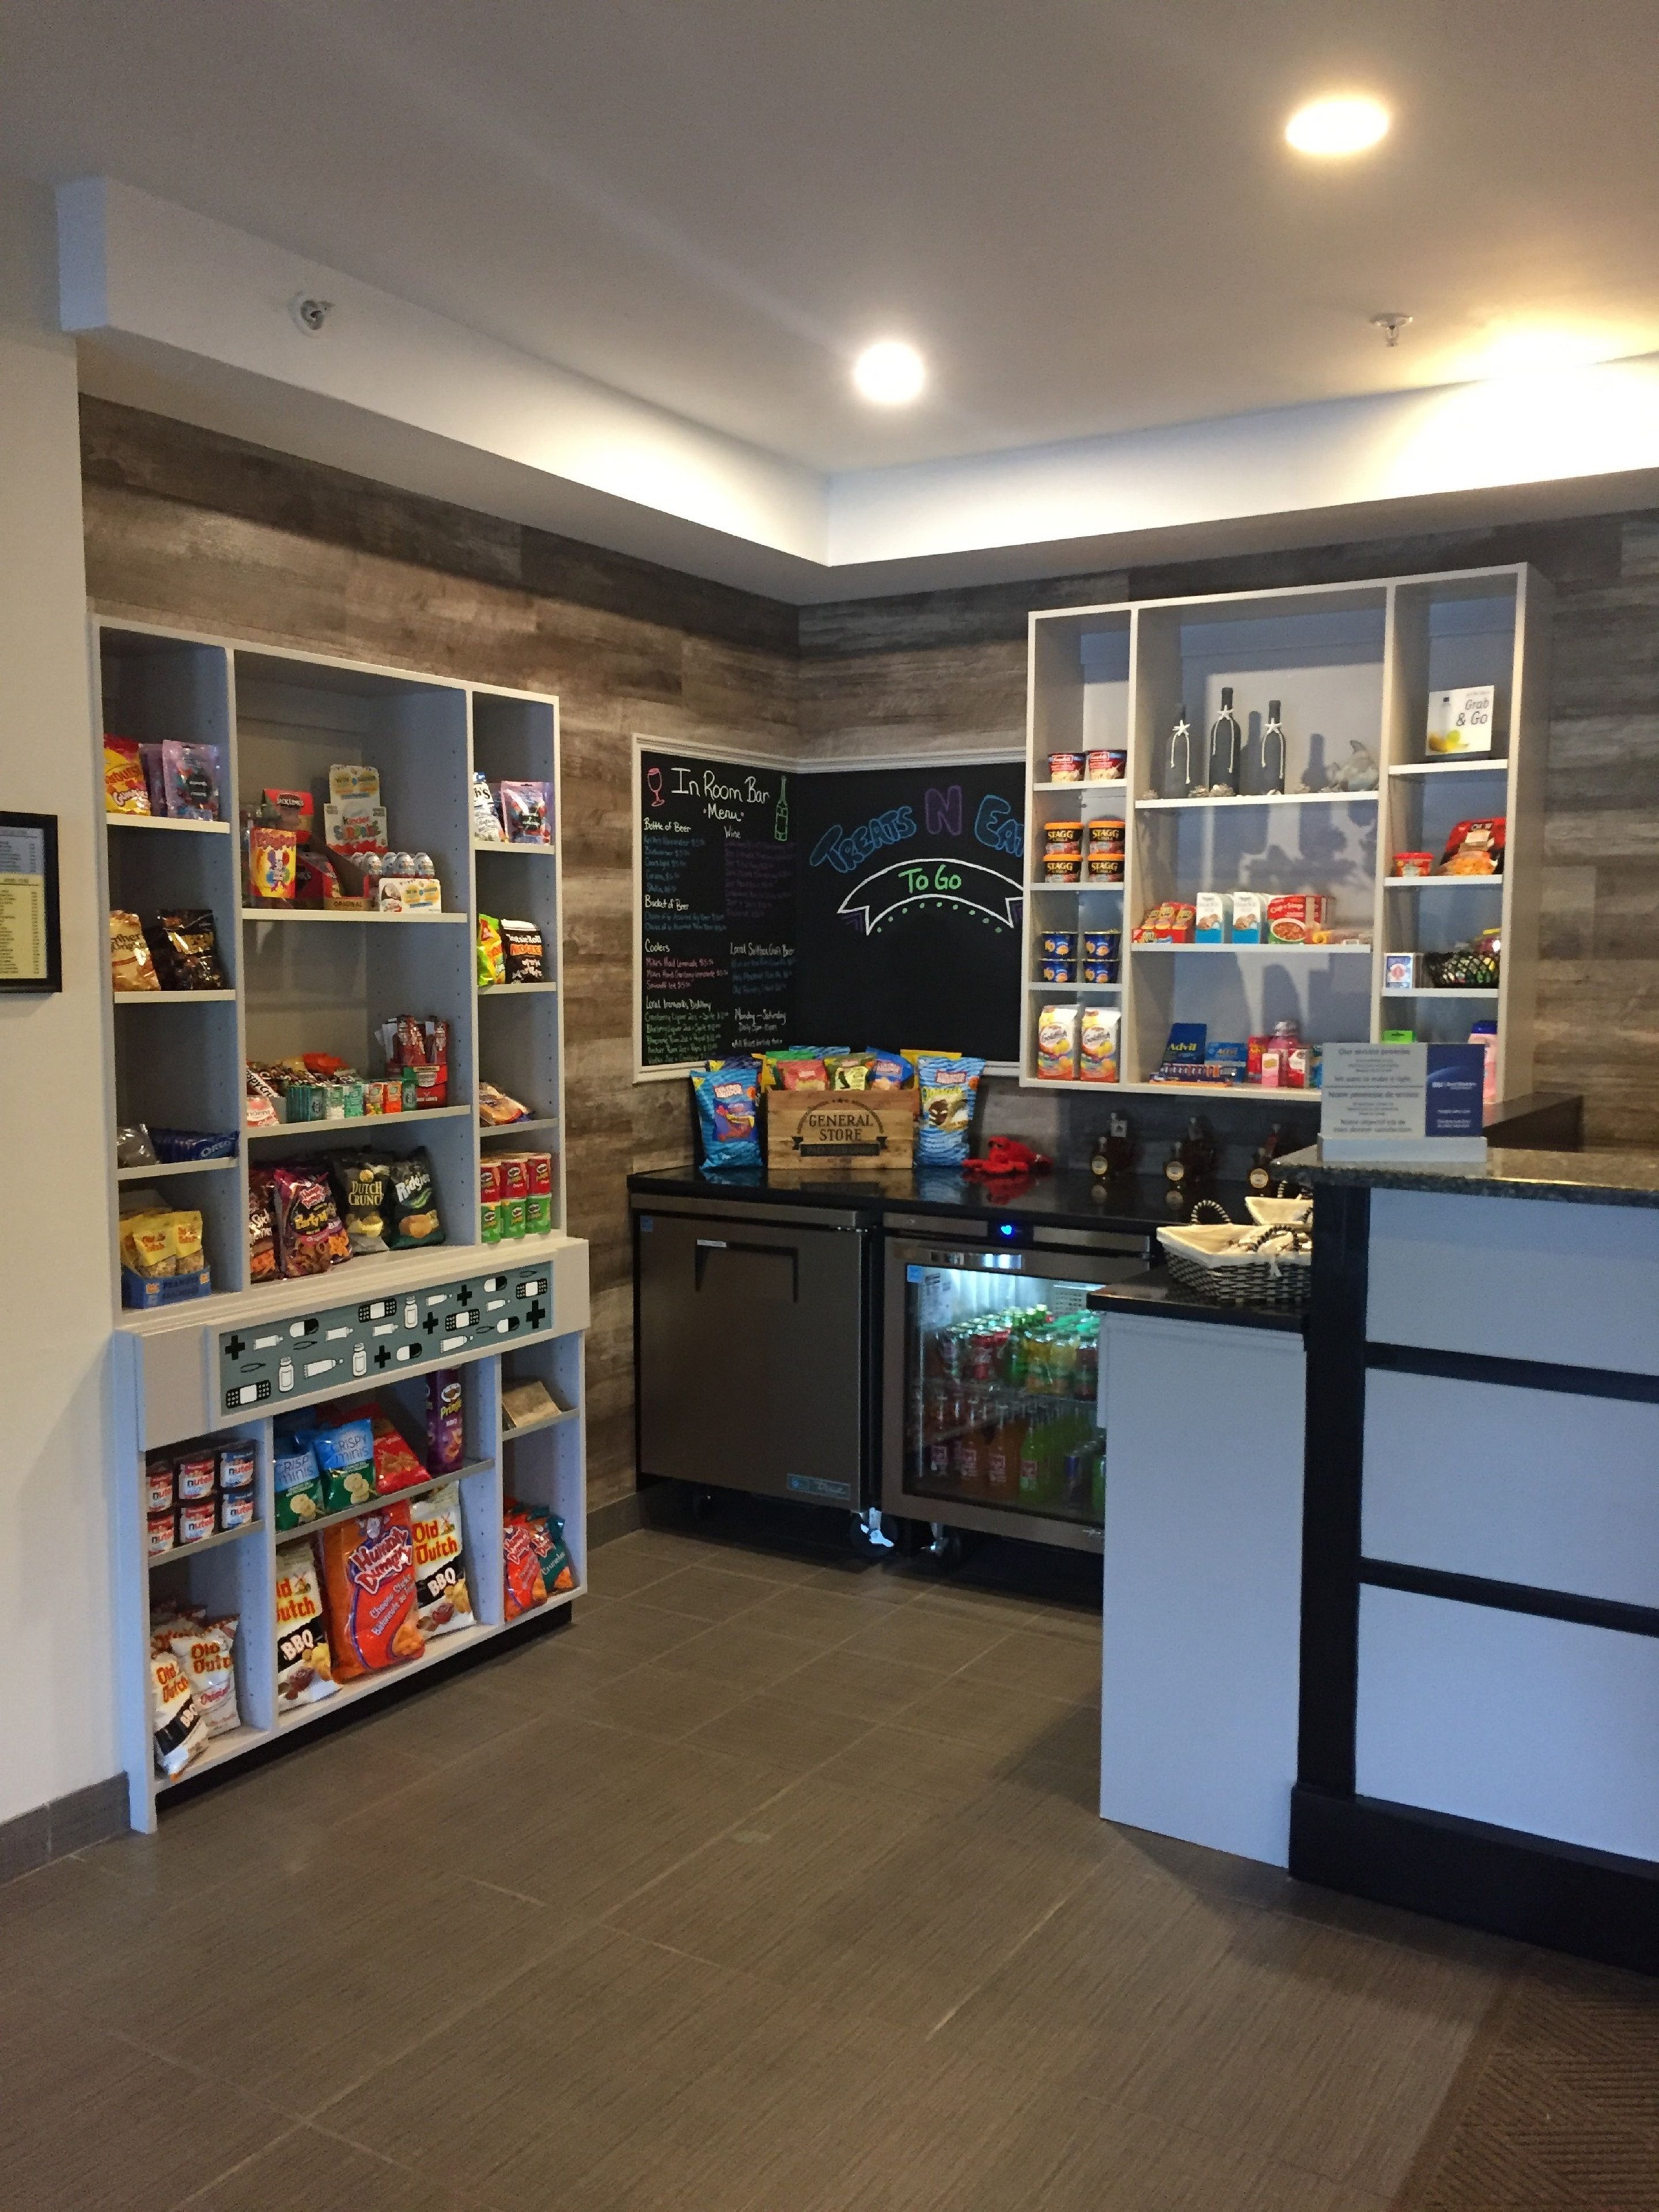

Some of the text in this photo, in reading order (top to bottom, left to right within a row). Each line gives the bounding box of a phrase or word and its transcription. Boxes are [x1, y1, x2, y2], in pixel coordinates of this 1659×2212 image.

[1465, 698, 1490, 710] Grab
[1456, 711, 1488, 726] & Go
[671, 767, 770, 804] In Room Bar
[708, 803, 742, 822] Menu
[643, 817, 691, 833] Bottle of Beer
[724, 825, 741, 839] Wine
[810, 806, 917, 874] TREATS
[924, 785, 963, 836] N
[1092, 828, 1120, 839] STAGG
[1047, 830, 1074, 840] STAGG
[1047, 862, 1073, 872] STAGG
[1091, 862, 1118, 872] STAGG
[645, 894, 690, 911] Bucket of Beer
[645, 938, 671, 953] Coolers
[734, 1007, 755, 1026] Monday
[762, 1009, 787, 1025] Saturday
[1168, 1043, 1197, 1051] Advil
[809, 1114, 874, 1127] GENERAL
[819, 1128, 863, 1142] STORE
[200, 1141, 231, 1158] OREO
[351, 1180, 382, 1195] DUTCH
[331, 1434, 367, 1453] CRISPY
[335, 1446, 369, 1464] minis
[412, 1521, 439, 1544] Old
[349, 1527, 410, 1573] Humpty
[416, 1536, 459, 1566] Dutch
[276, 1578, 292, 1599] ld
[427, 1567, 456, 1597] BBQ
[191, 1642, 220, 1660] Old
[280, 1628, 315, 1661] BBQ
[156, 1663, 176, 1685] Old
[180, 1703, 199, 1728] BBQ
